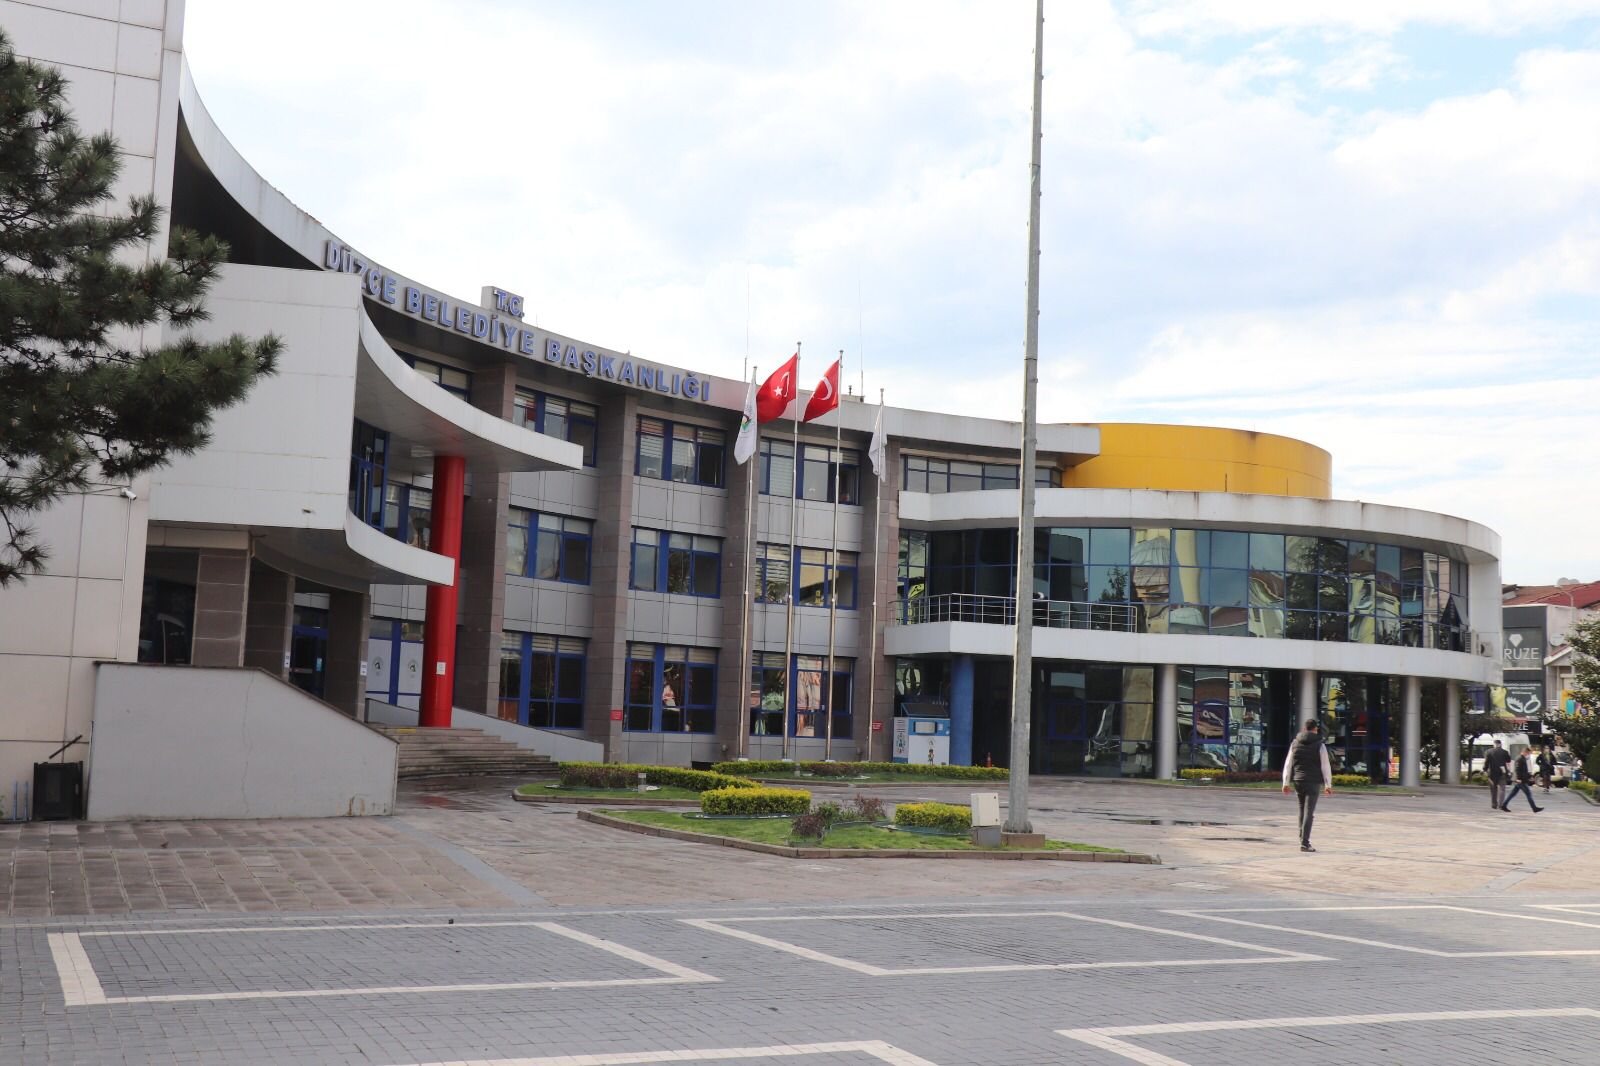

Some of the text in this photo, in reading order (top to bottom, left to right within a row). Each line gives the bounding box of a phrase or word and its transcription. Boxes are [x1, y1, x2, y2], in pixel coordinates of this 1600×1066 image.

[494, 286, 524, 317] T.C.
[405, 286, 534, 356] BELEDİYE
[545, 337, 710, 401] BAŞKANLIĞI
